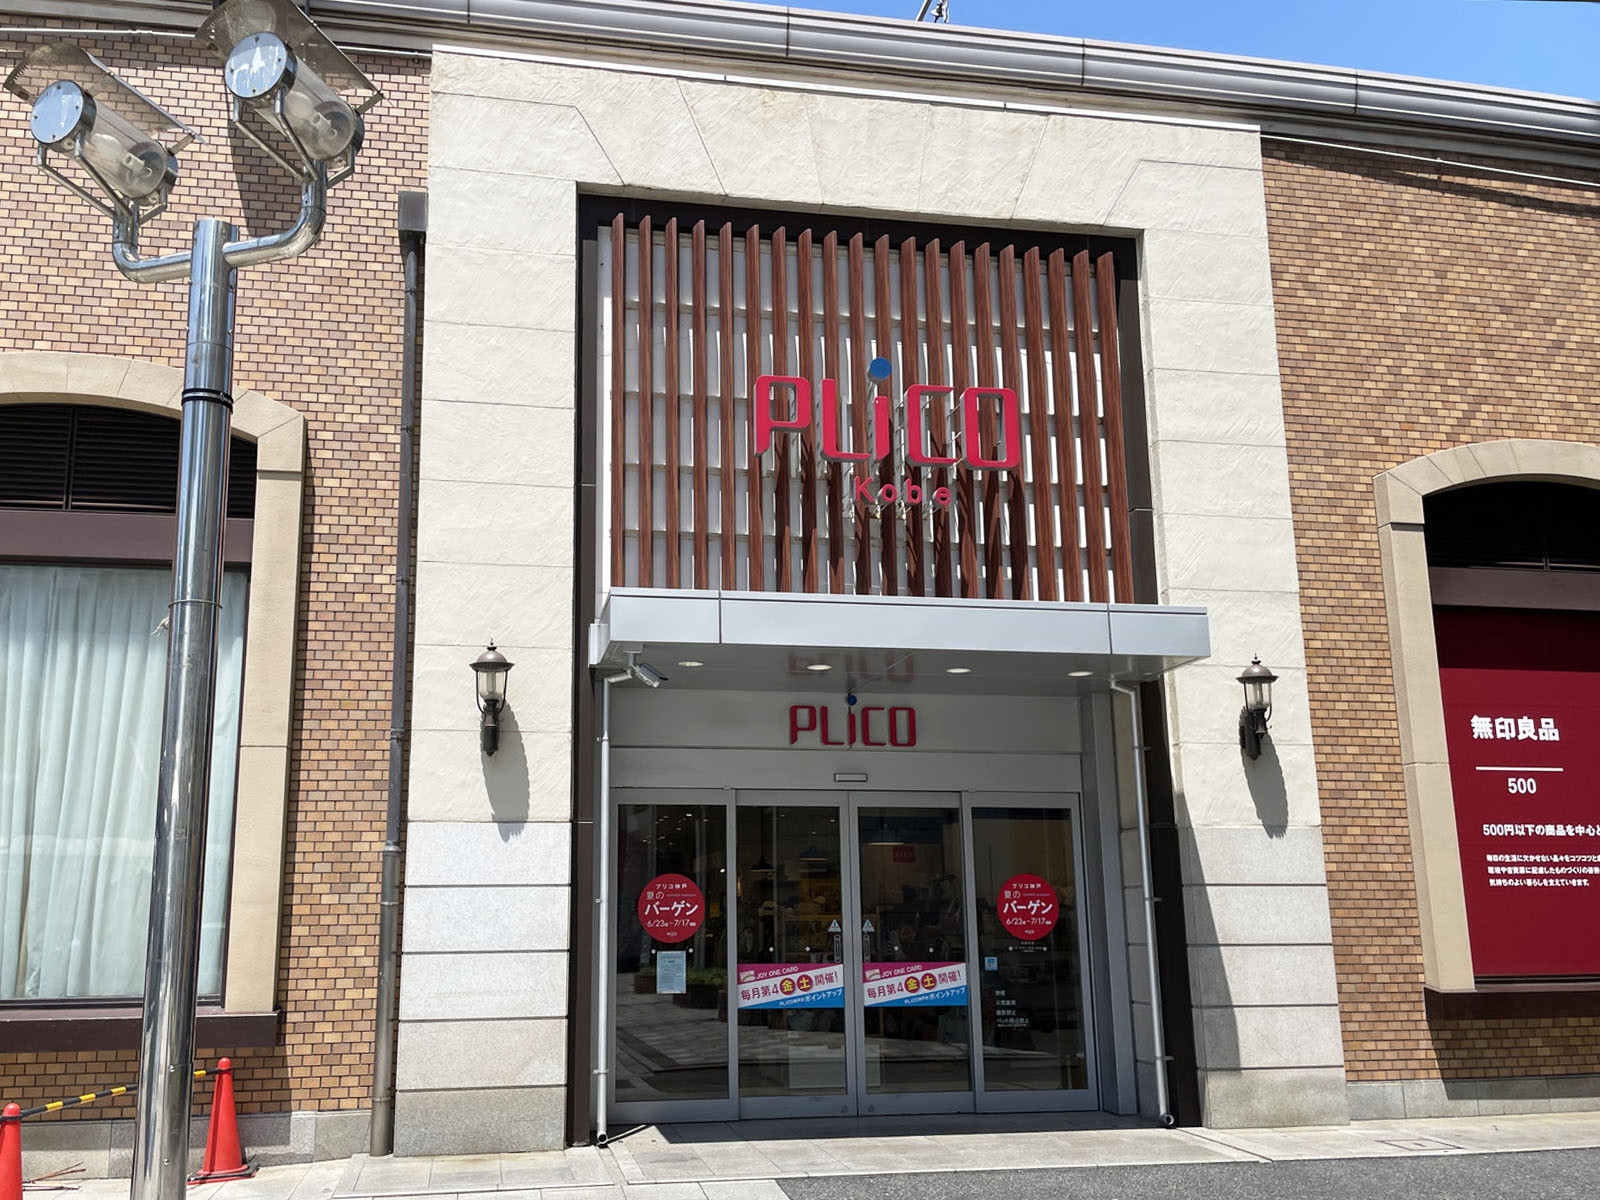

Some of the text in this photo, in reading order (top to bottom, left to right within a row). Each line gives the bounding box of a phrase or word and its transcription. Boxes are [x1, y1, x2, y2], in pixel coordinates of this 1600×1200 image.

[853, 476, 952, 505] Kobe
[1470, 714, 1560, 741] 無印良品
[1507, 777, 1537, 794] 500
[646, 891, 665, 900] 夏の
[1004, 890, 1021, 900] 夏の
[644, 900, 699, 917] バーゲン
[1003, 899, 1053, 915] バーゲン
[756, 965, 799, 980] JOY ONE CARD
[881, 964, 923, 978] JOY ONE CARD
